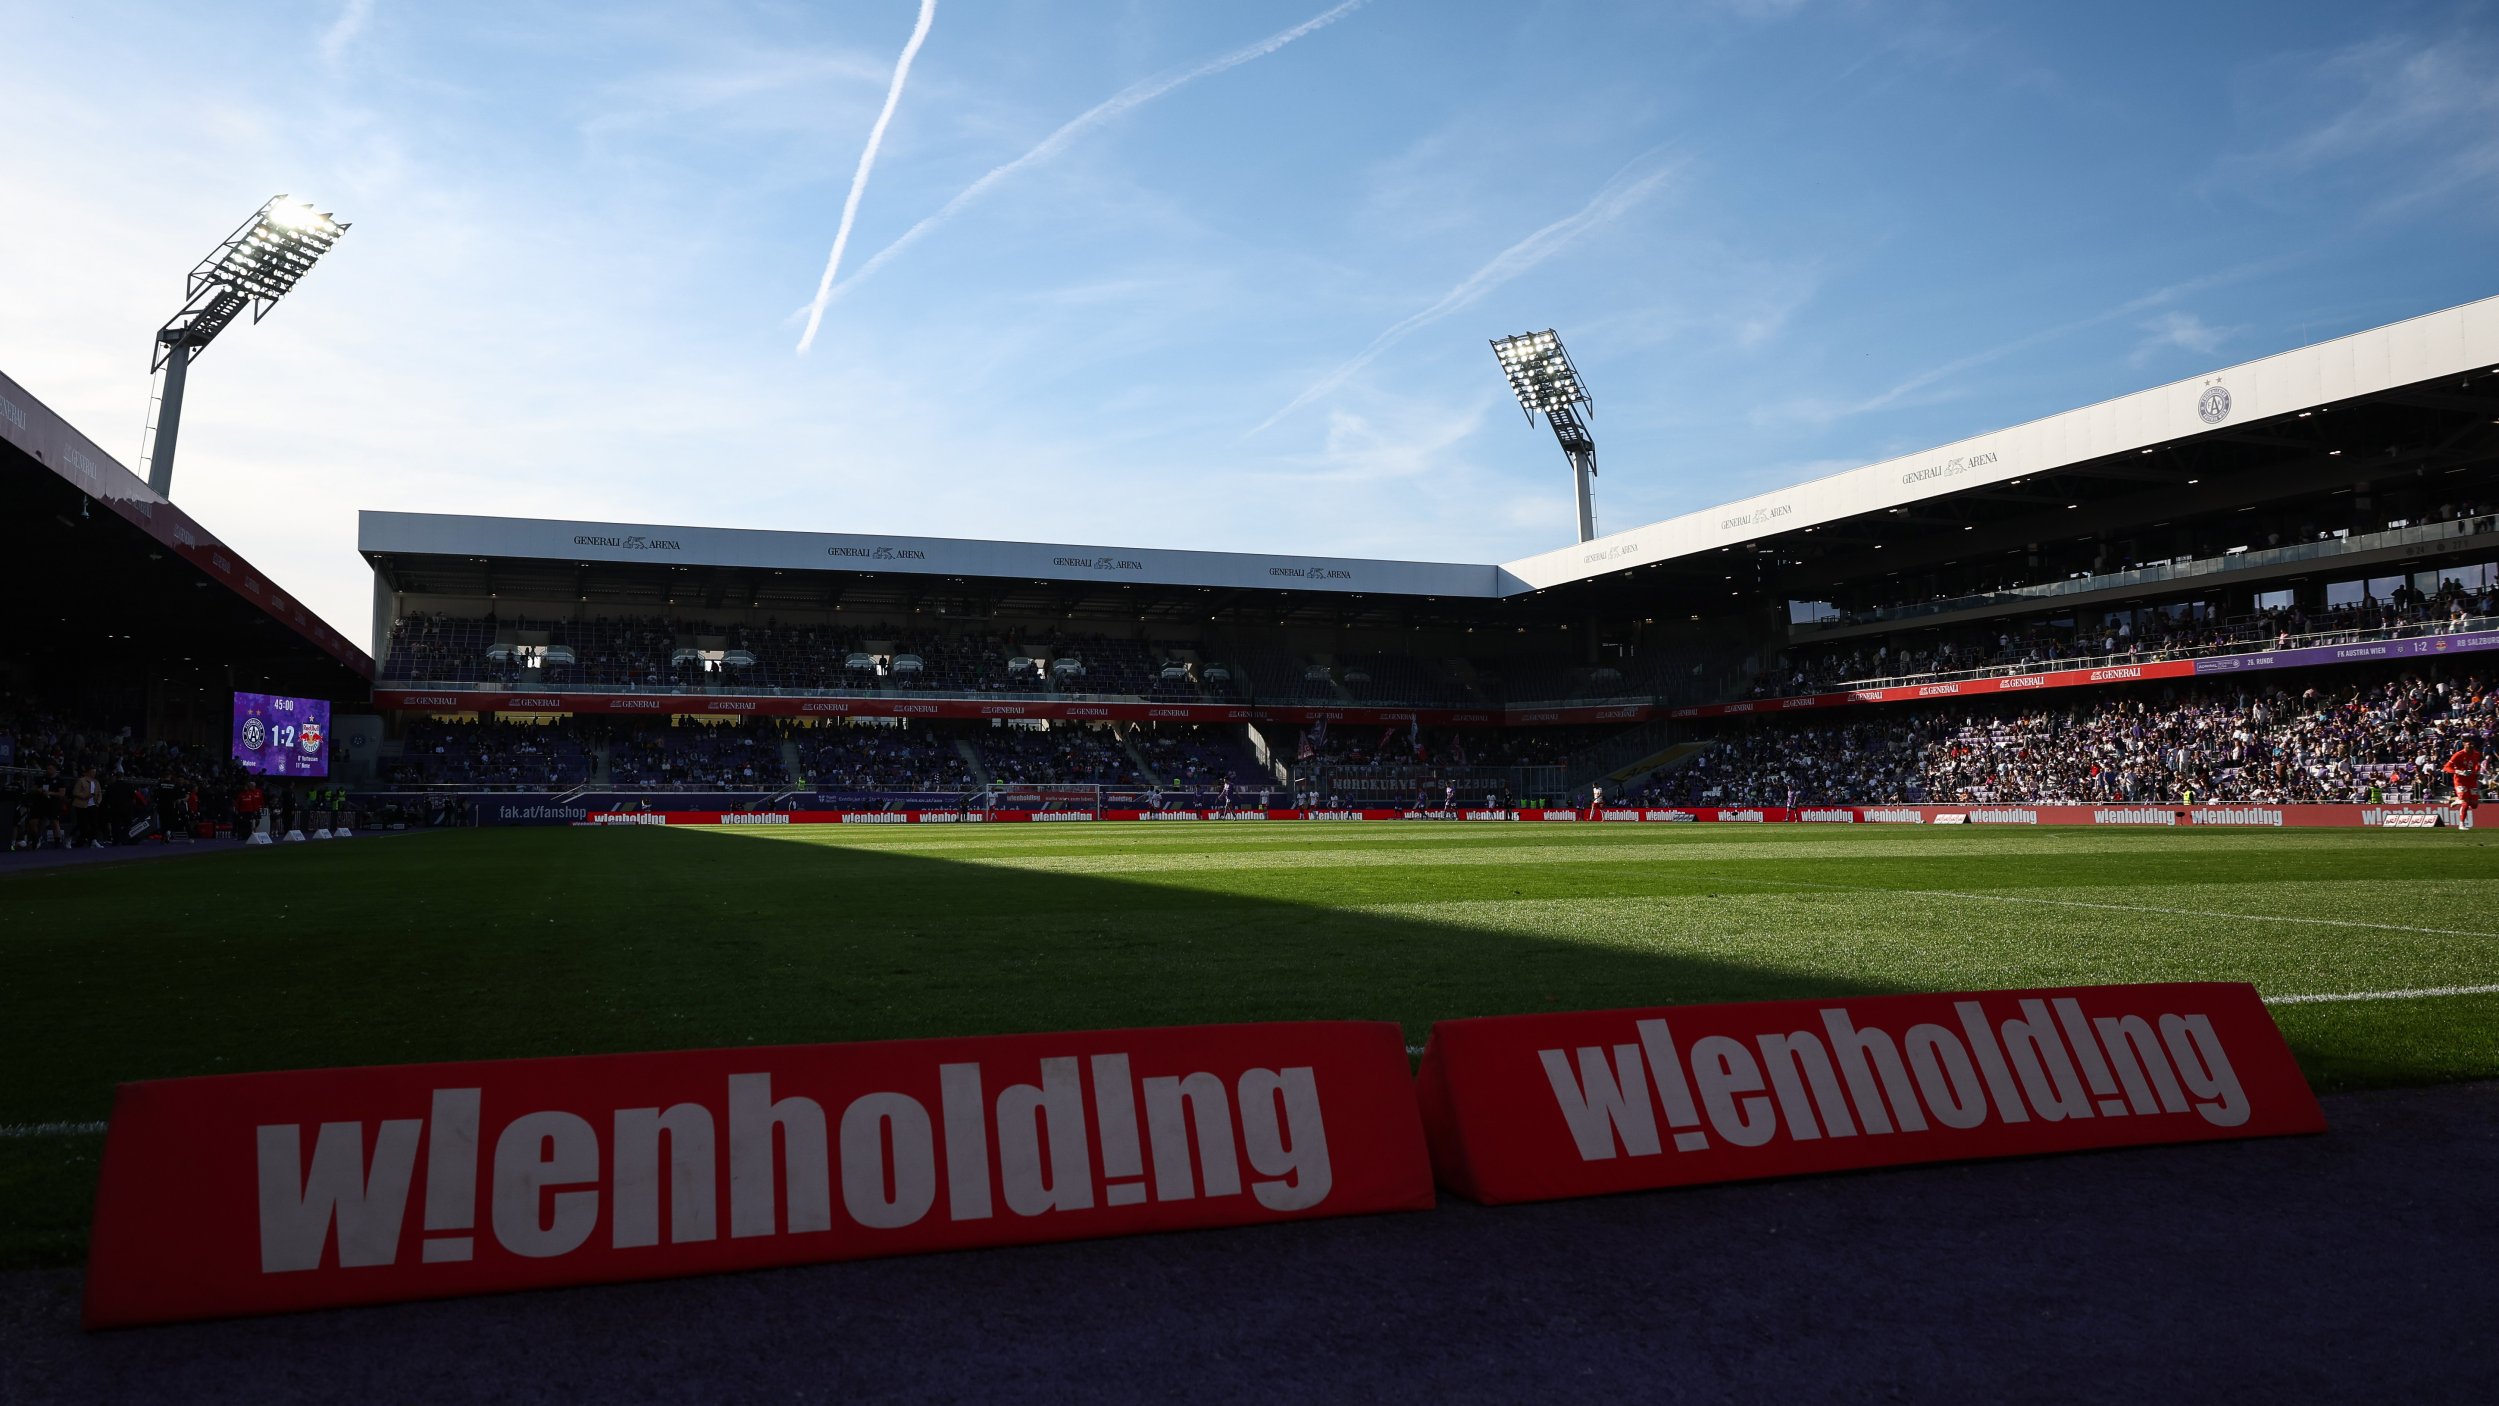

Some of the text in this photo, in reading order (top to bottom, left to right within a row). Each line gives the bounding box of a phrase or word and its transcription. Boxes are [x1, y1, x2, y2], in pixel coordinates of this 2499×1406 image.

[0, 394, 26, 431] NERALI
[1902, 452, 1998, 484] GENERALI ARENA
[1721, 505, 1792, 529] GENERALI ARENA
[574, 536, 680, 550] GENERALI ARENA
[828, 547, 925, 559] GENERALI ARENA
[1583, 543, 1638, 564] GENERALI ARENA
[1053, 557, 1142, 569] GENERALI ARENA
[1269, 568, 1351, 579] GENERALI ARENA
[2345, 649, 2370, 657] AUSTRIA
[2370, 647, 2386, 655] WIEN
[2414, 642, 2427, 652] 1:2
[2102, 668, 2141, 679] GENERALI
[2010, 677, 2044, 687] GENERALI
[1928, 684, 1958, 695] GENERALI
[416, 697, 457, 705] GENERALI
[1790, 697, 1814, 707] GENERALI
[1856, 692, 1882, 701] GENERALI
[274, 699, 294, 711] 45:00
[520, 698, 560, 707] GENERALI
[622, 700, 660, 708] GENERALI
[719, 702, 756, 710] GENERALI
[903, 705, 938, 713] GENERALI
[991, 706, 1025, 714] GENERALI
[1158, 709, 1189, 717] GENERALI
[271, 725, 295, 747] 1:2
[1333, 778, 1506, 790] NORDKURVE SLZBURG
[500, 805, 586, 820] fak.at/fanshop
